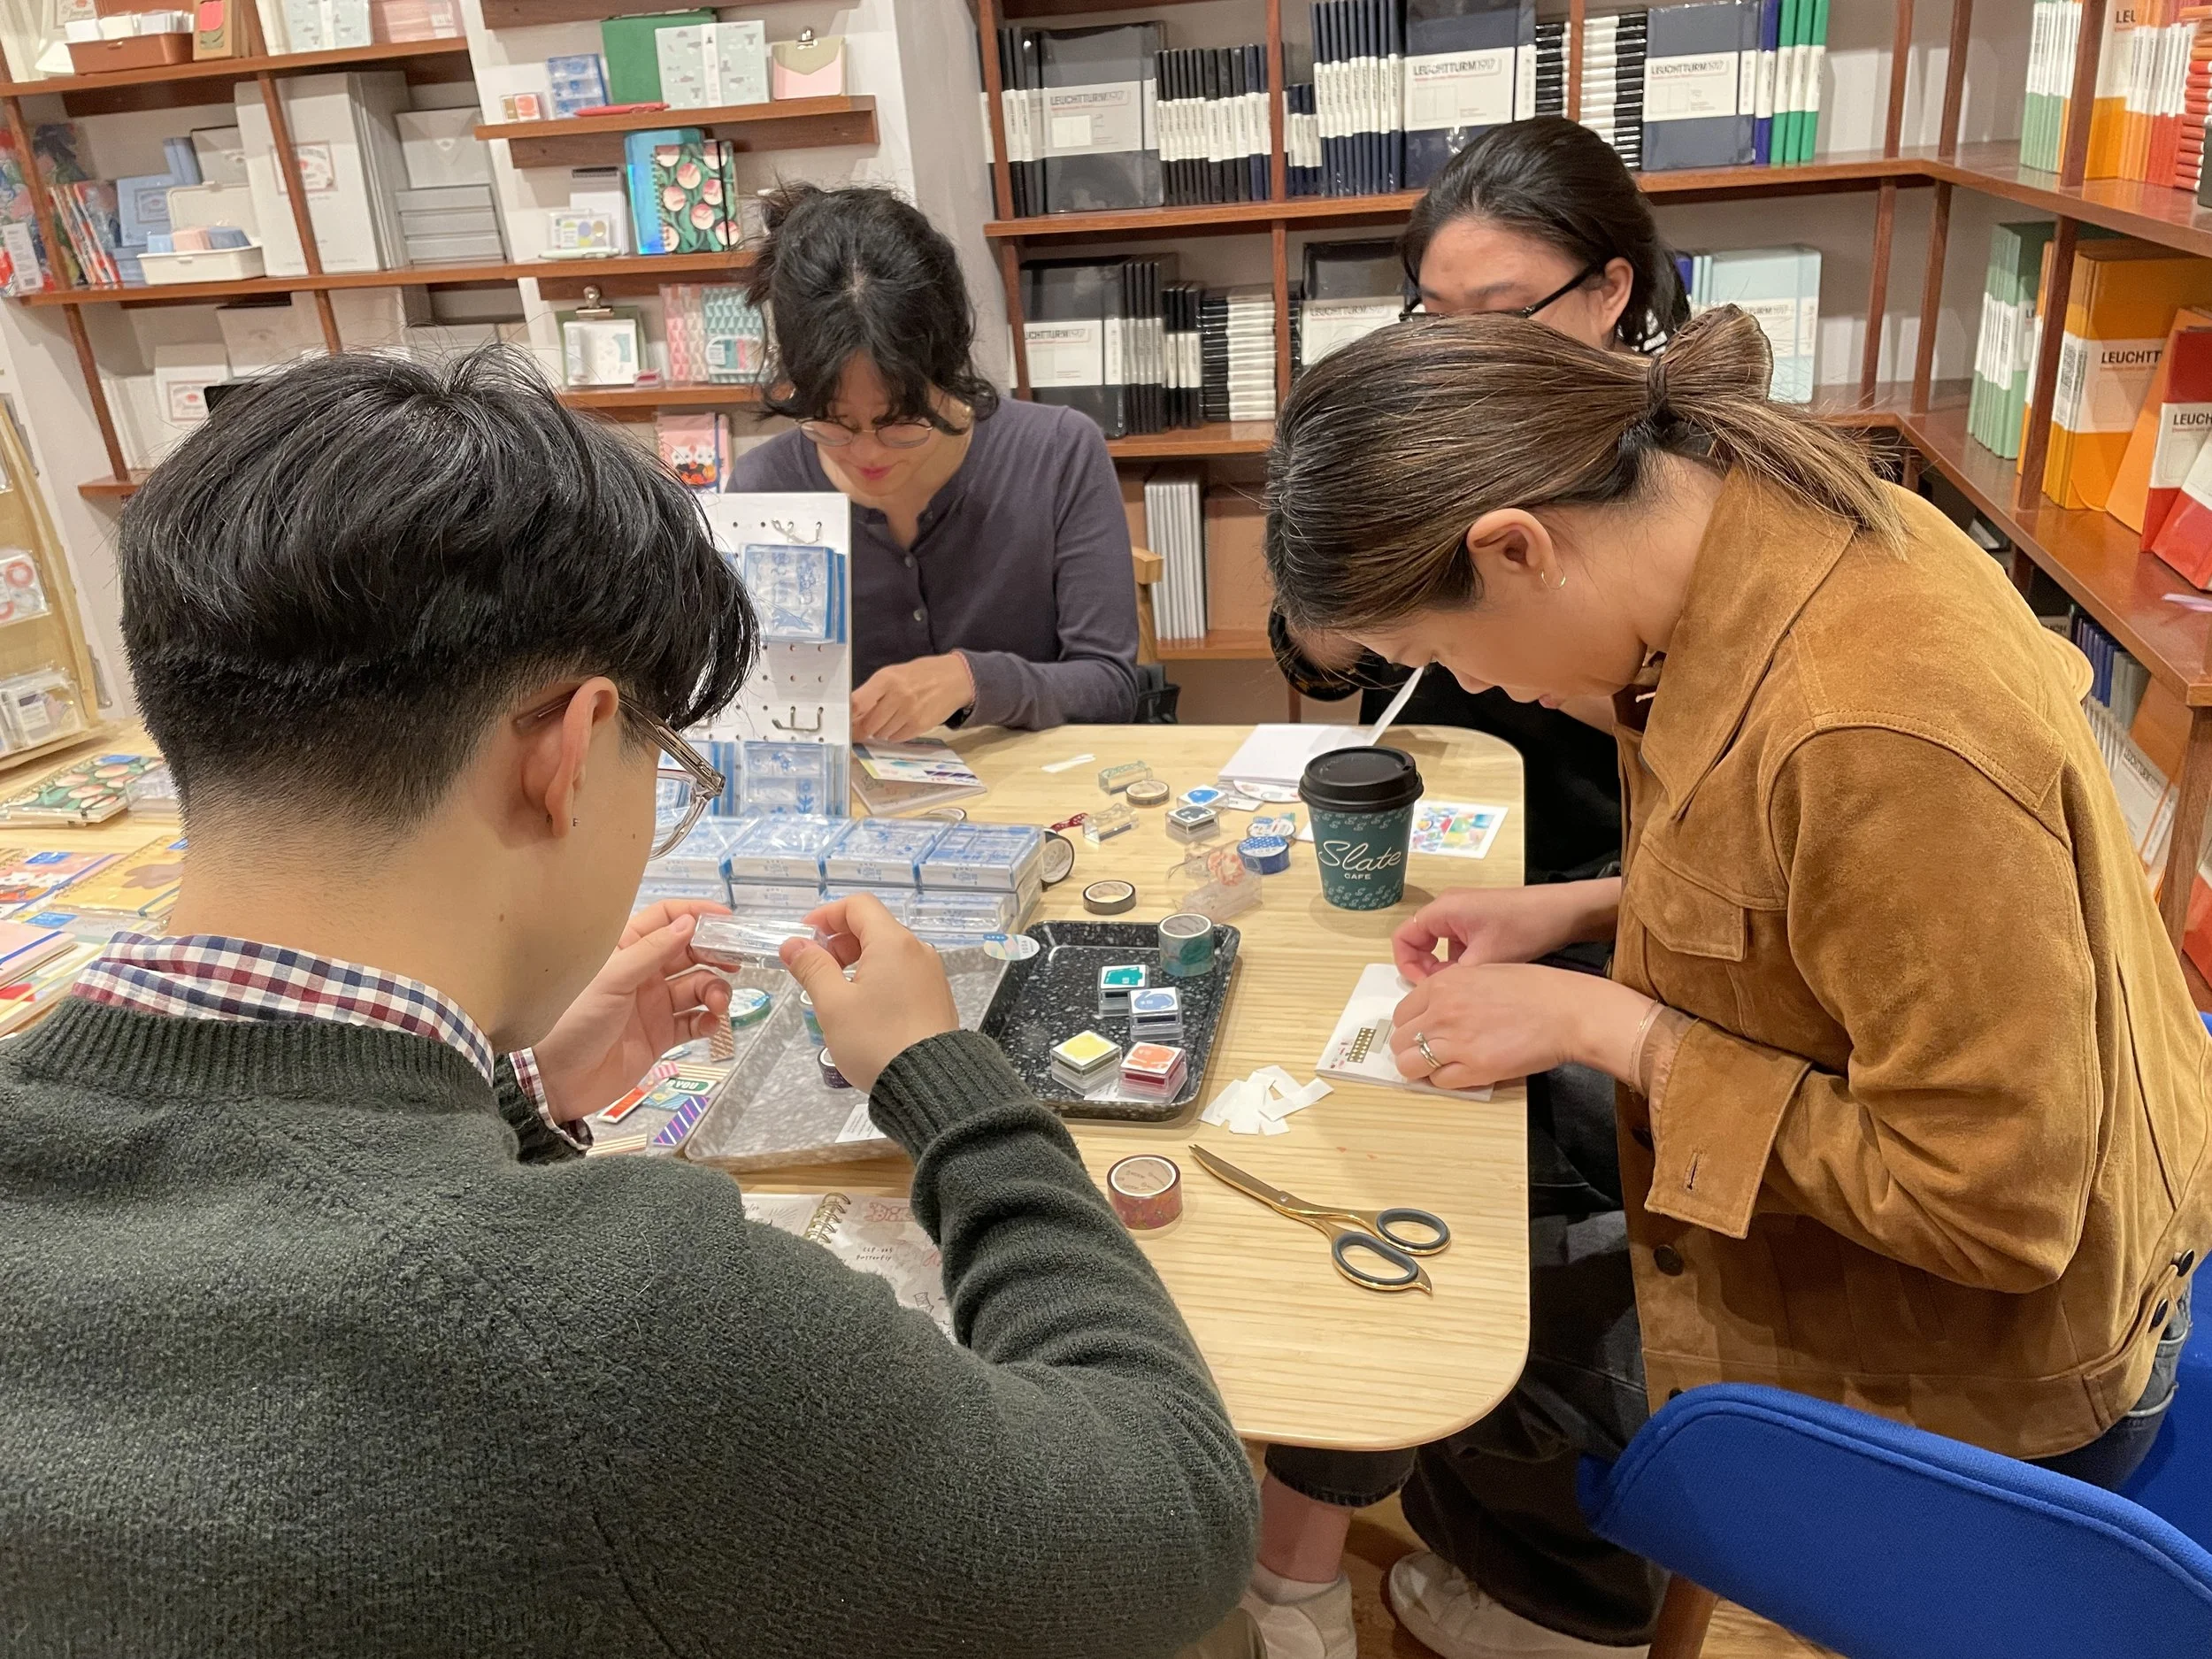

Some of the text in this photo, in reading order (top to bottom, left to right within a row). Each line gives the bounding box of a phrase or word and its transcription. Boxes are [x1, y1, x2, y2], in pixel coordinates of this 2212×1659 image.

[1318, 840, 1402, 872] Slate
[1344, 872, 1371, 881] CAFE
[676, 1080, 700, 1090] YOU
